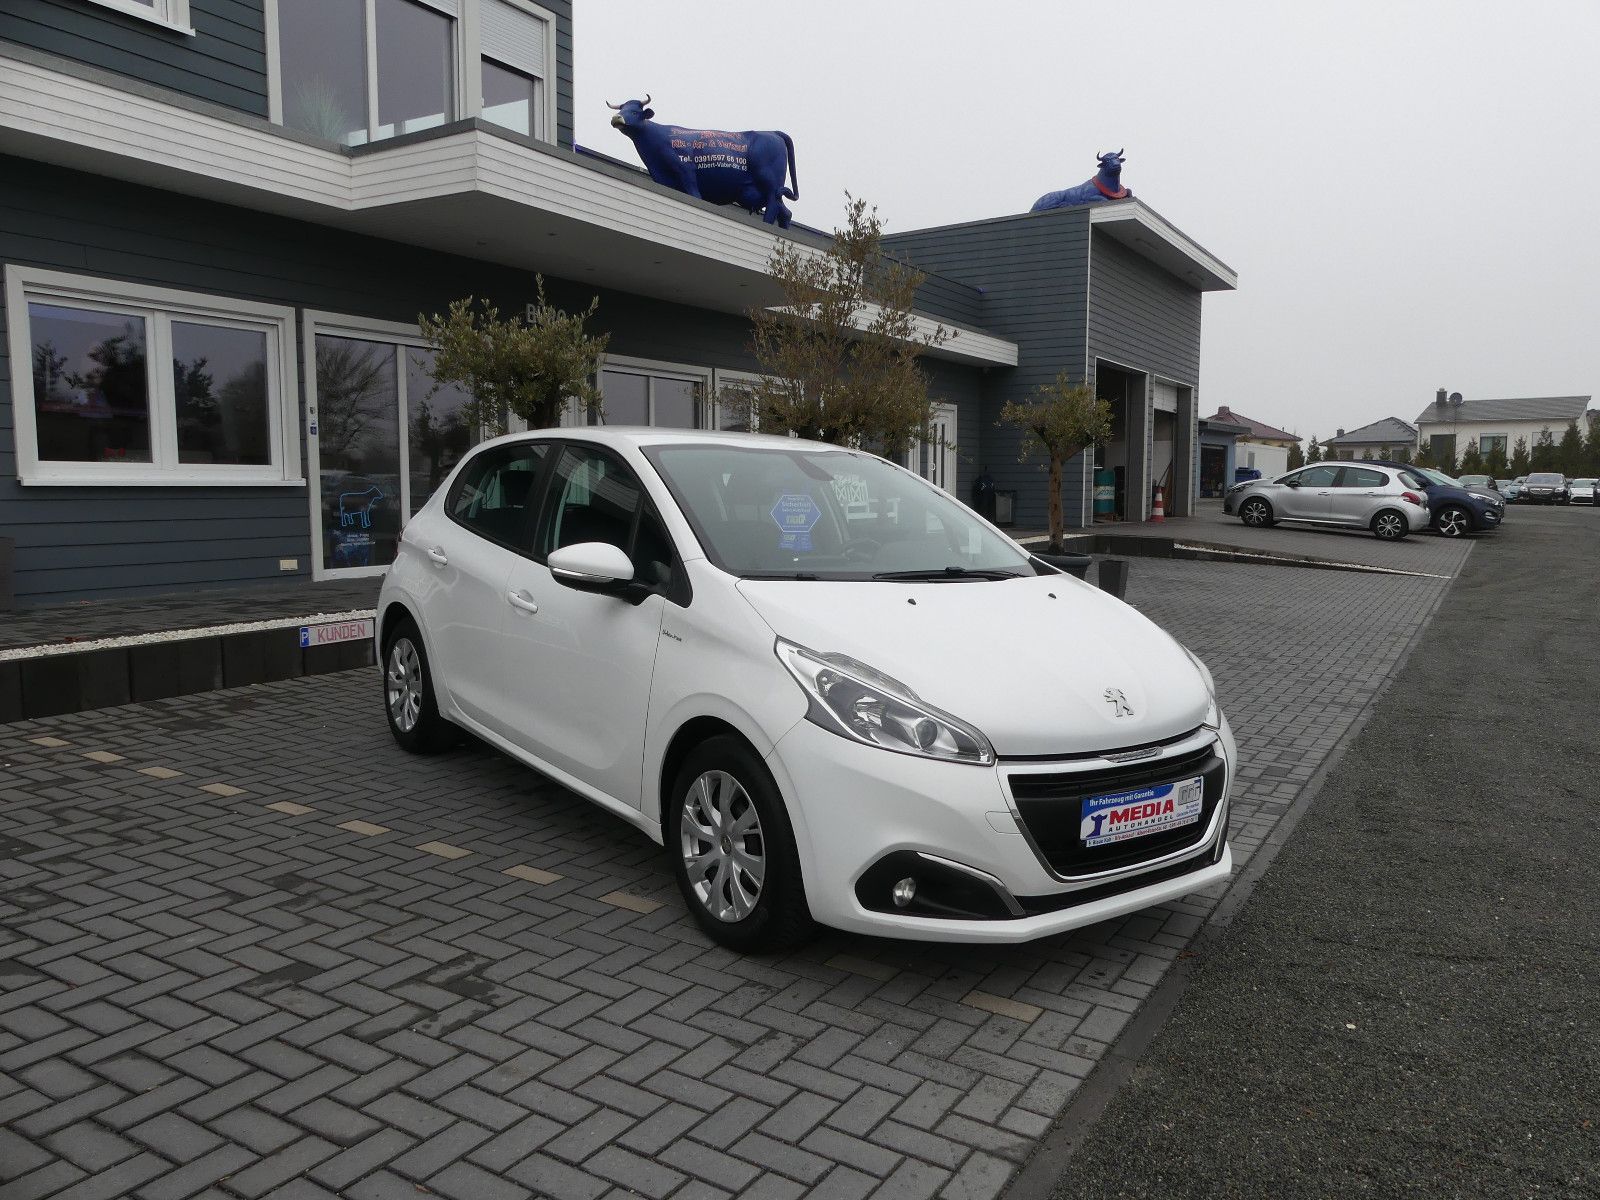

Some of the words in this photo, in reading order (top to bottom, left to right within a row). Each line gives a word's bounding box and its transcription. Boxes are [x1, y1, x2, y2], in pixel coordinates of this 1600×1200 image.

[694, 154, 725, 163] 0391/597
[736, 157, 747, 165] 100
[317, 623, 366, 643] KUNDEN
[1089, 798, 1098, 807] Ihr
[1099, 794, 1124, 805] Fahrzeug
[1124, 793, 1133, 802] mit
[1133, 789, 1154, 800] Garantie
[1109, 799, 1174, 825] MEDIA
[1108, 814, 1174, 832] AUTOHANDEL
